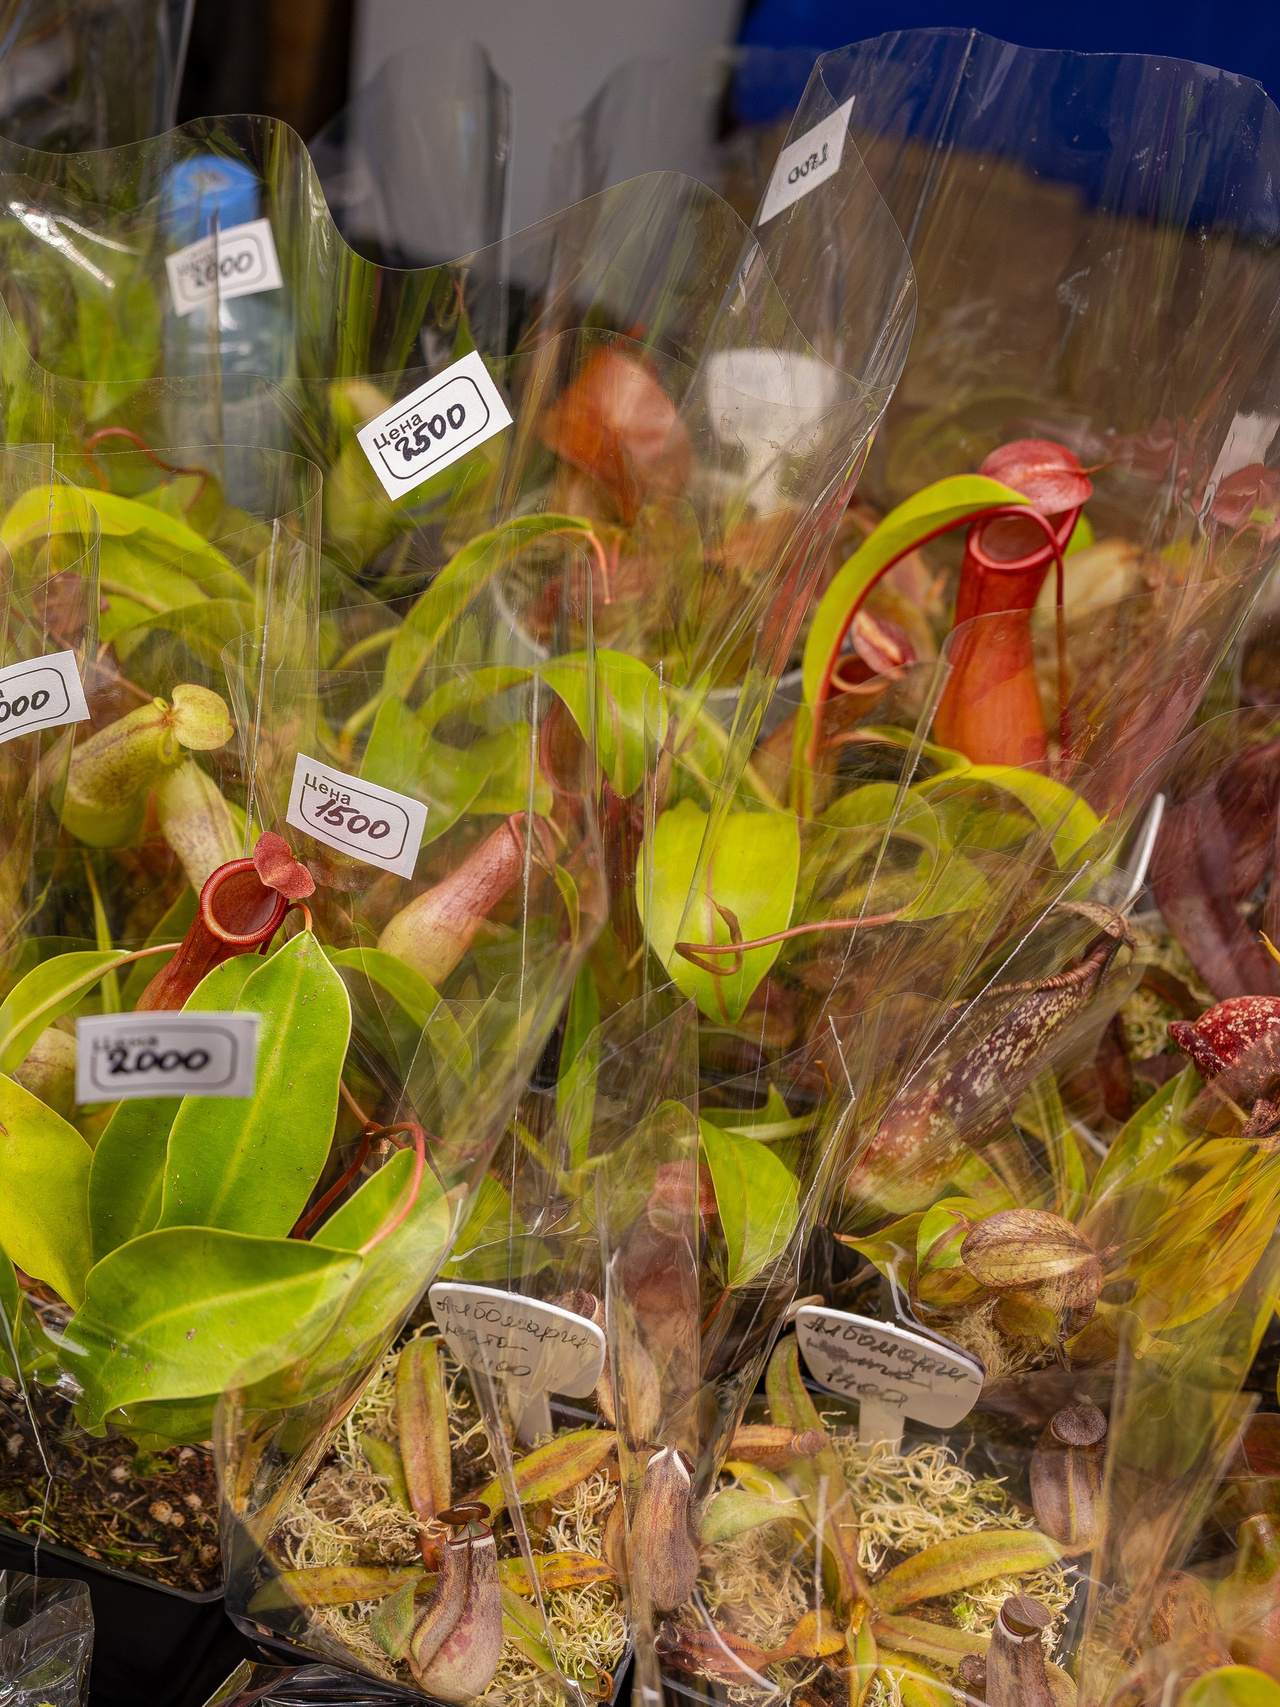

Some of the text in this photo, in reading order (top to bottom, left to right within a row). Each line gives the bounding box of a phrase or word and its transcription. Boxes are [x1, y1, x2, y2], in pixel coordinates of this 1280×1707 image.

[372, 413, 424, 450] Цена
[394, 403, 466, 462] 2500
[304, 772, 351, 806] Цена
[314, 798, 391, 839] 1500
[108, 1047, 210, 1075] 2000
